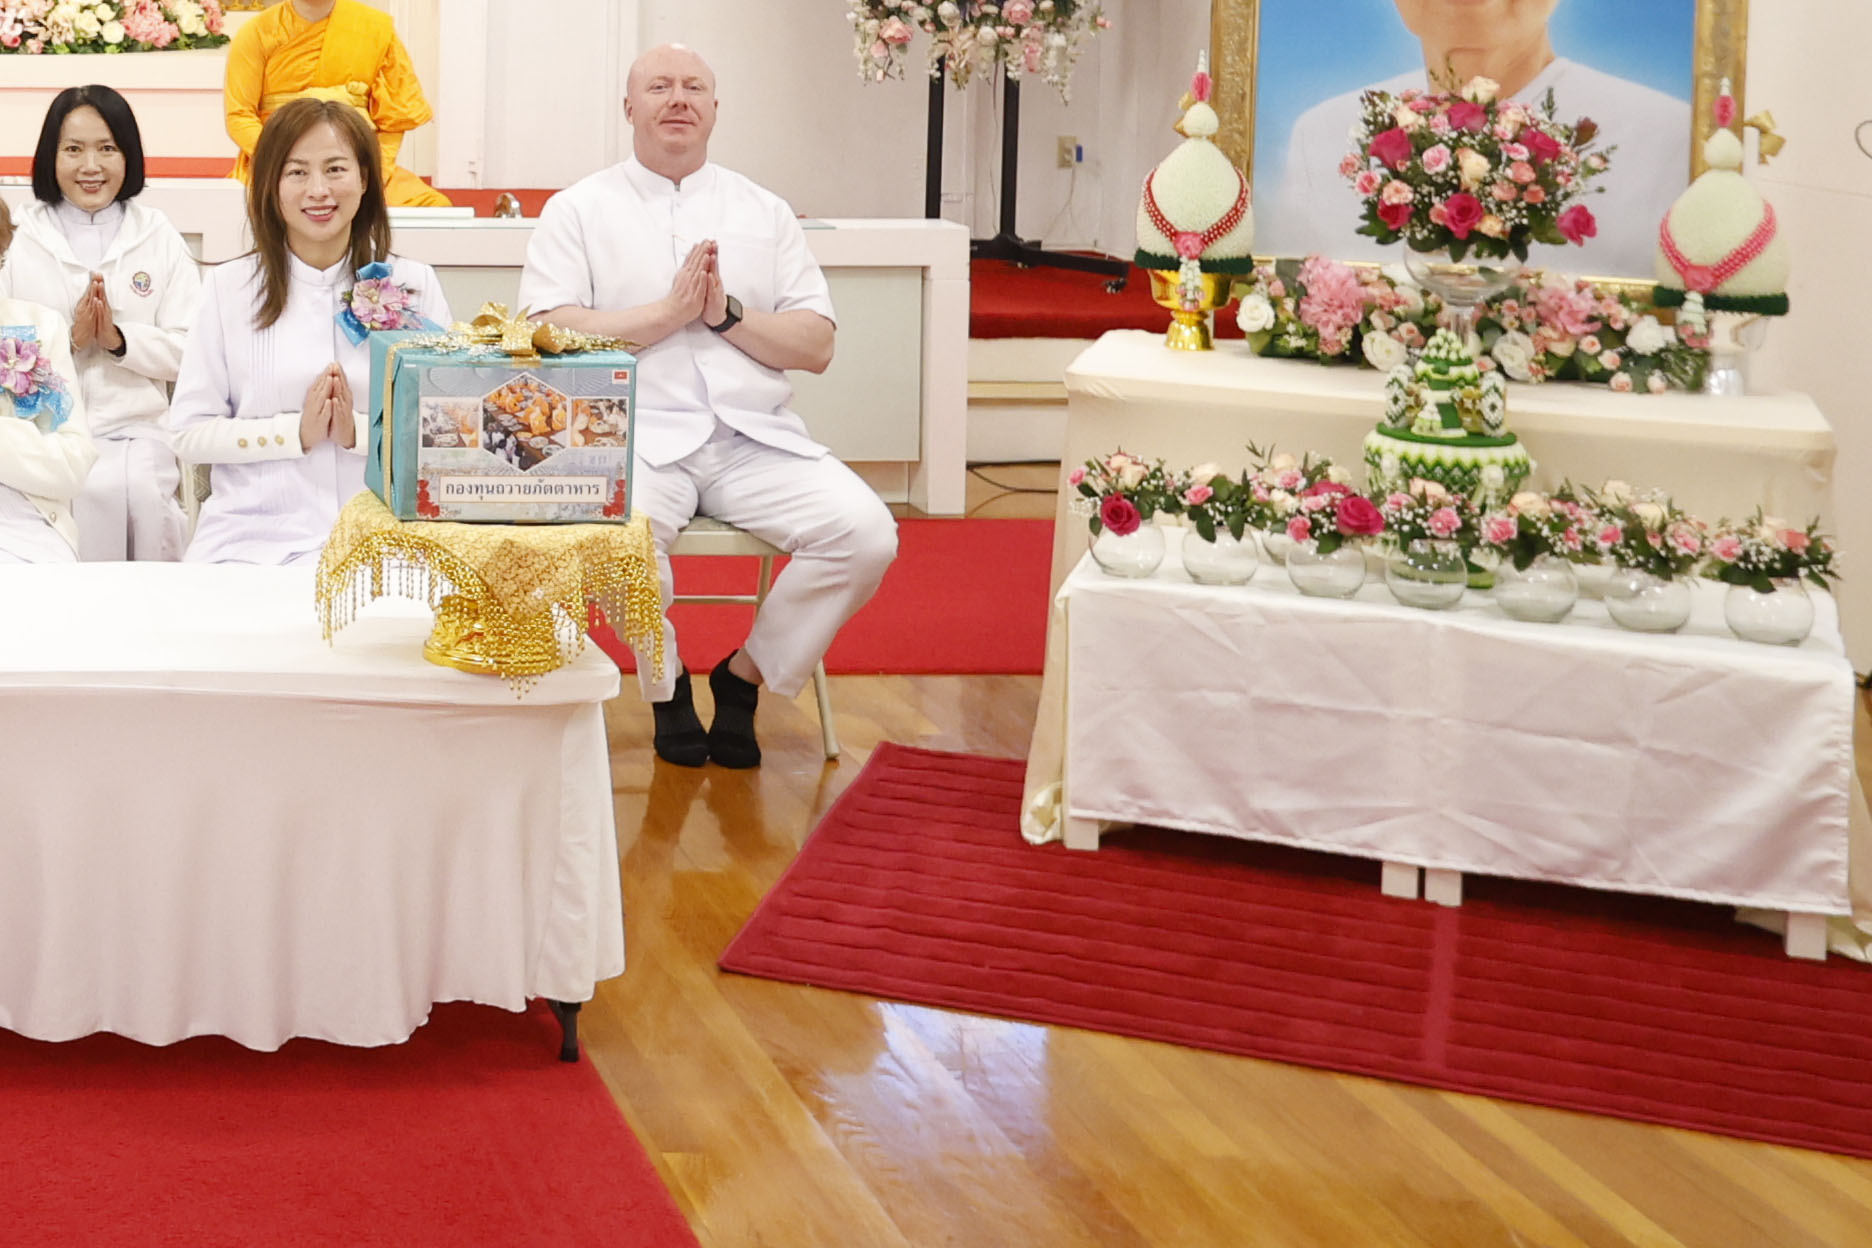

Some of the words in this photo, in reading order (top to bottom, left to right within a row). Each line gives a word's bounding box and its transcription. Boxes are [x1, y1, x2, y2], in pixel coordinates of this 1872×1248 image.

[445, 478, 600, 500] กองทุนถวายภัตตาหาร
